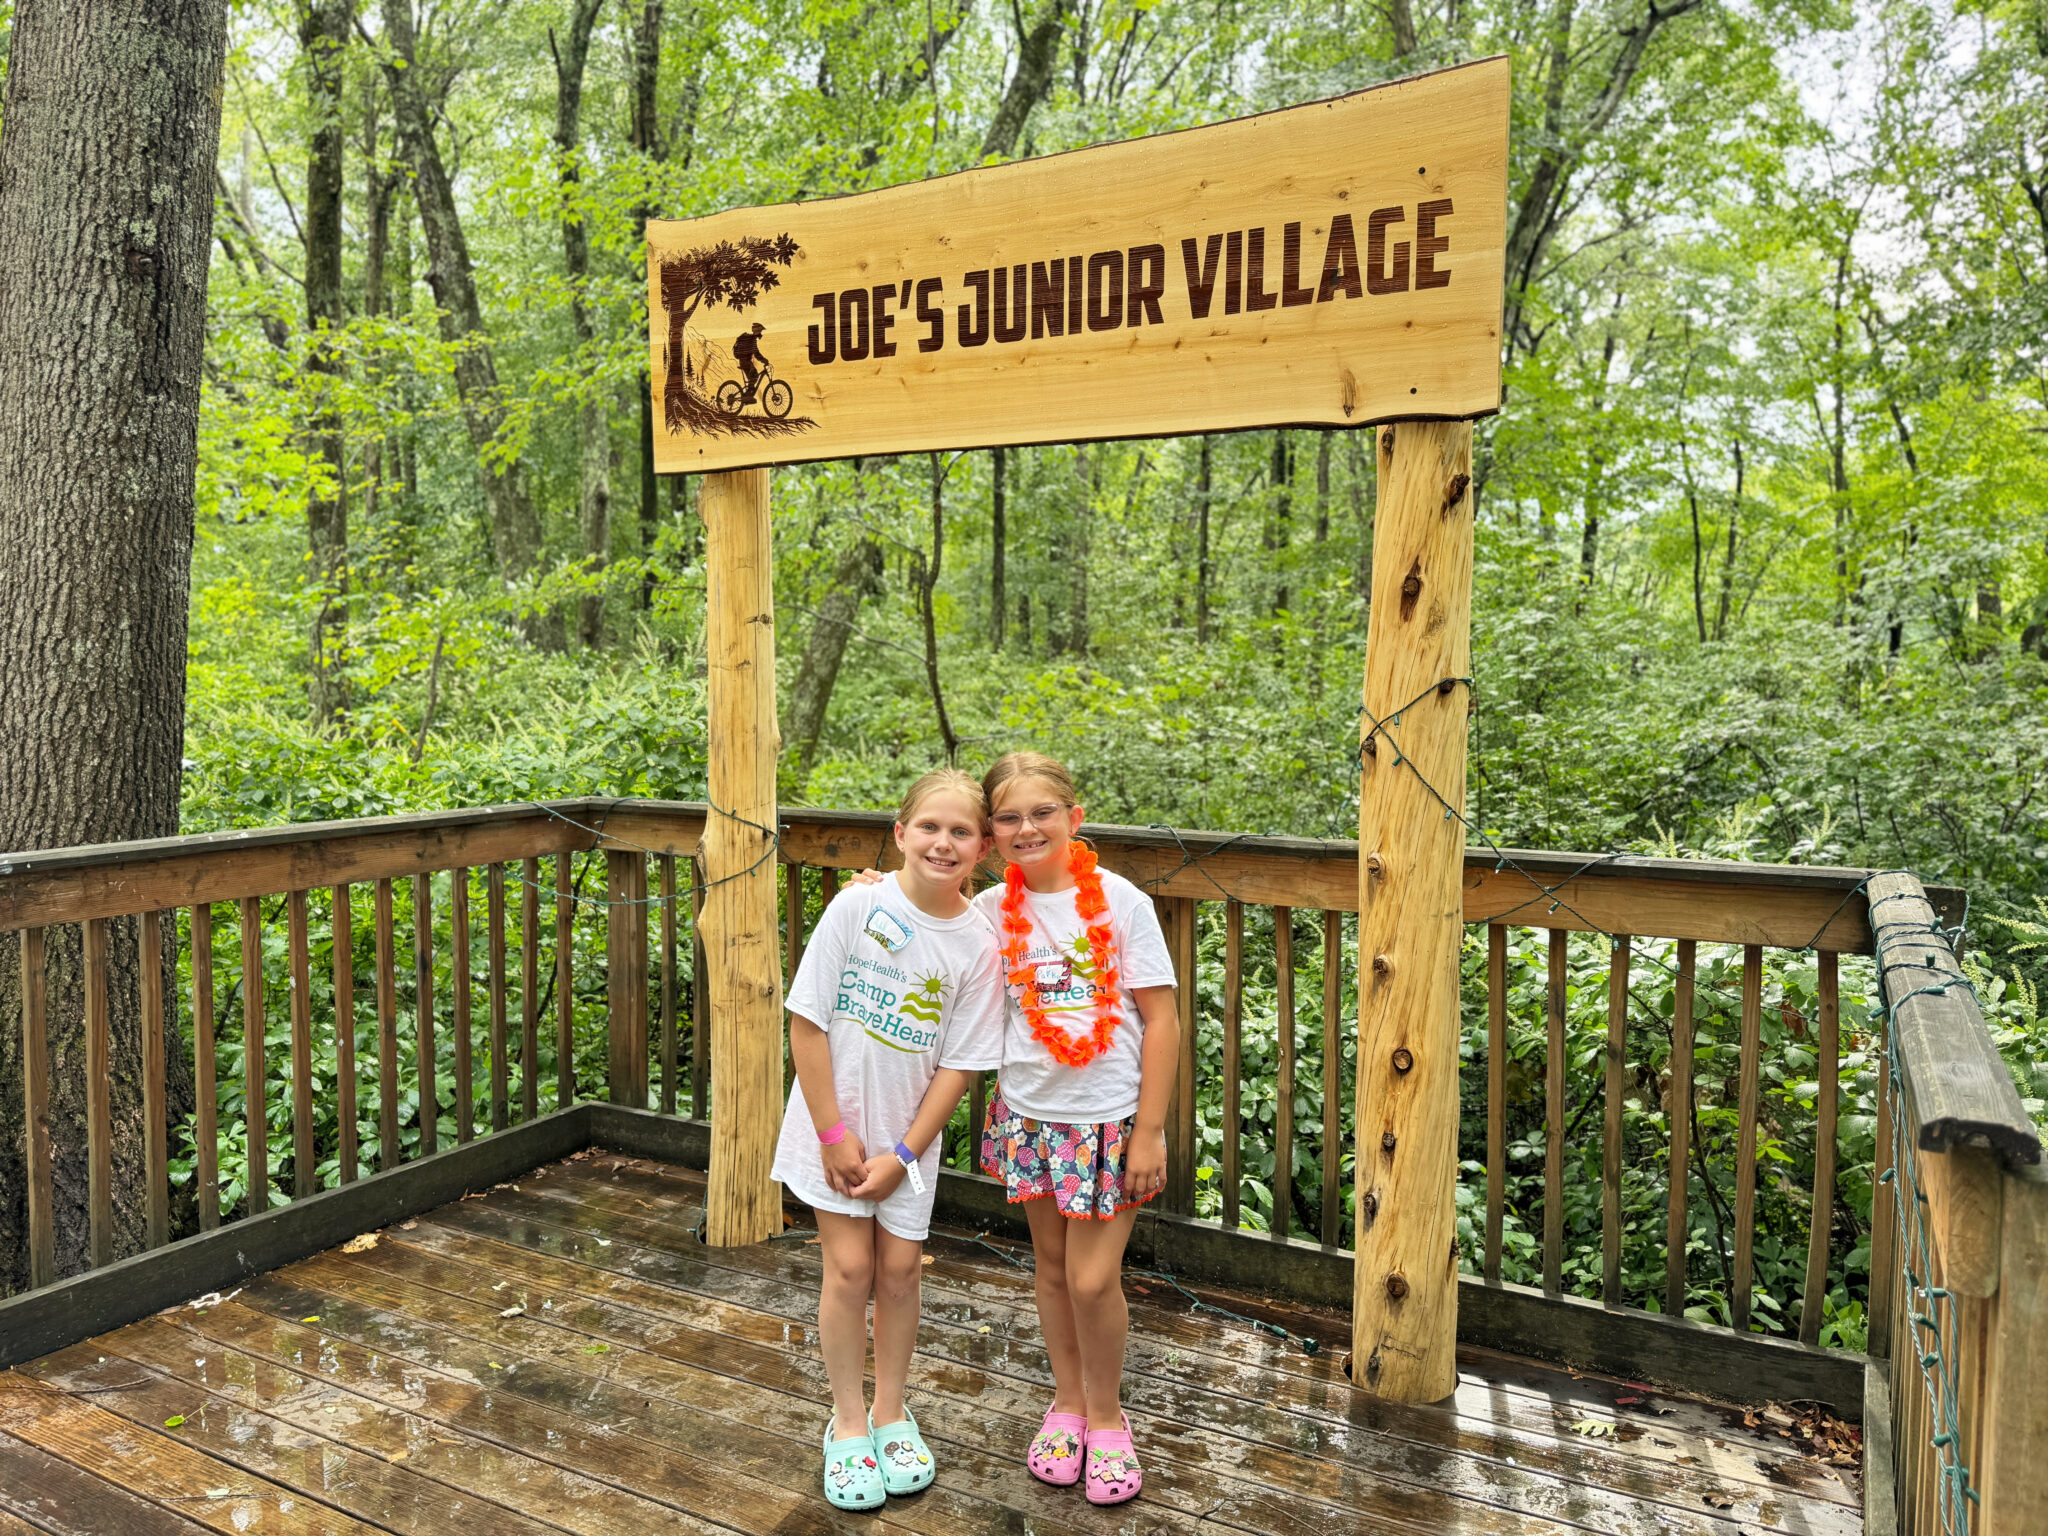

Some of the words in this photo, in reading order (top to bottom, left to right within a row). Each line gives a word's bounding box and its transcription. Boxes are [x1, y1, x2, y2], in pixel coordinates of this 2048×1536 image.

[807, 277, 944, 366] JOE'S
[957, 244, 1165, 348] JUNIOR
[1181, 198, 1454, 320] VILLAGE
[840, 970, 897, 1010] Camp
[835, 993, 938, 1048] BraveHeart
